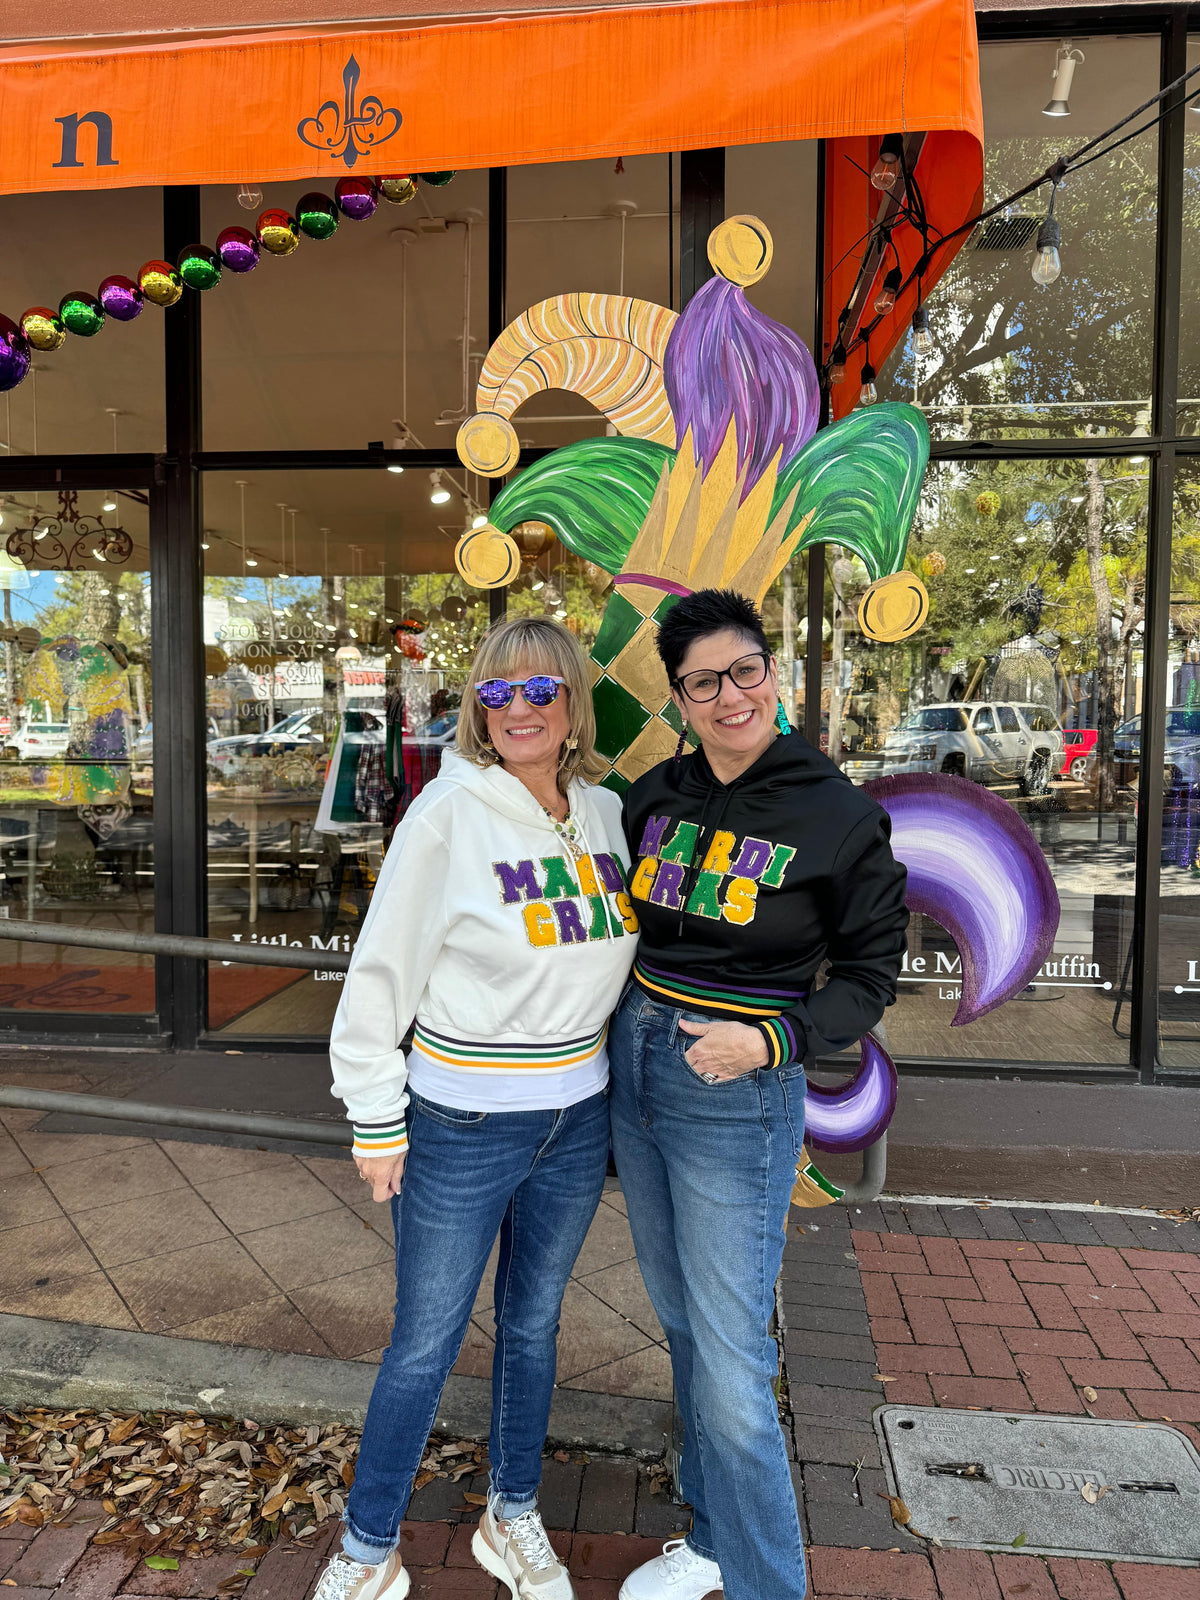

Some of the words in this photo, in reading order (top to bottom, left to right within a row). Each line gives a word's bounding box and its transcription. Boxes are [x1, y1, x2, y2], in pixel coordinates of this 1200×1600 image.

[220, 623, 272, 640] STORE
[278, 623, 336, 640] HOURS
[233, 644, 272, 658] MON
[287, 644, 317, 658] SAT
[258, 682, 291, 697] SUN
[235, 703, 273, 717] 10:00
[637, 815, 797, 889] MARDI
[630, 856, 759, 926] GRAS
[521, 890, 640, 950] GRAS
[309, 934, 358, 952] Mi
[1036, 954, 1101, 978] uffin
[1186, 960, 1200, 982] L
[938, 986, 963, 1000] Lak
[1000, 1466, 1101, 1493] ELECTRIC
